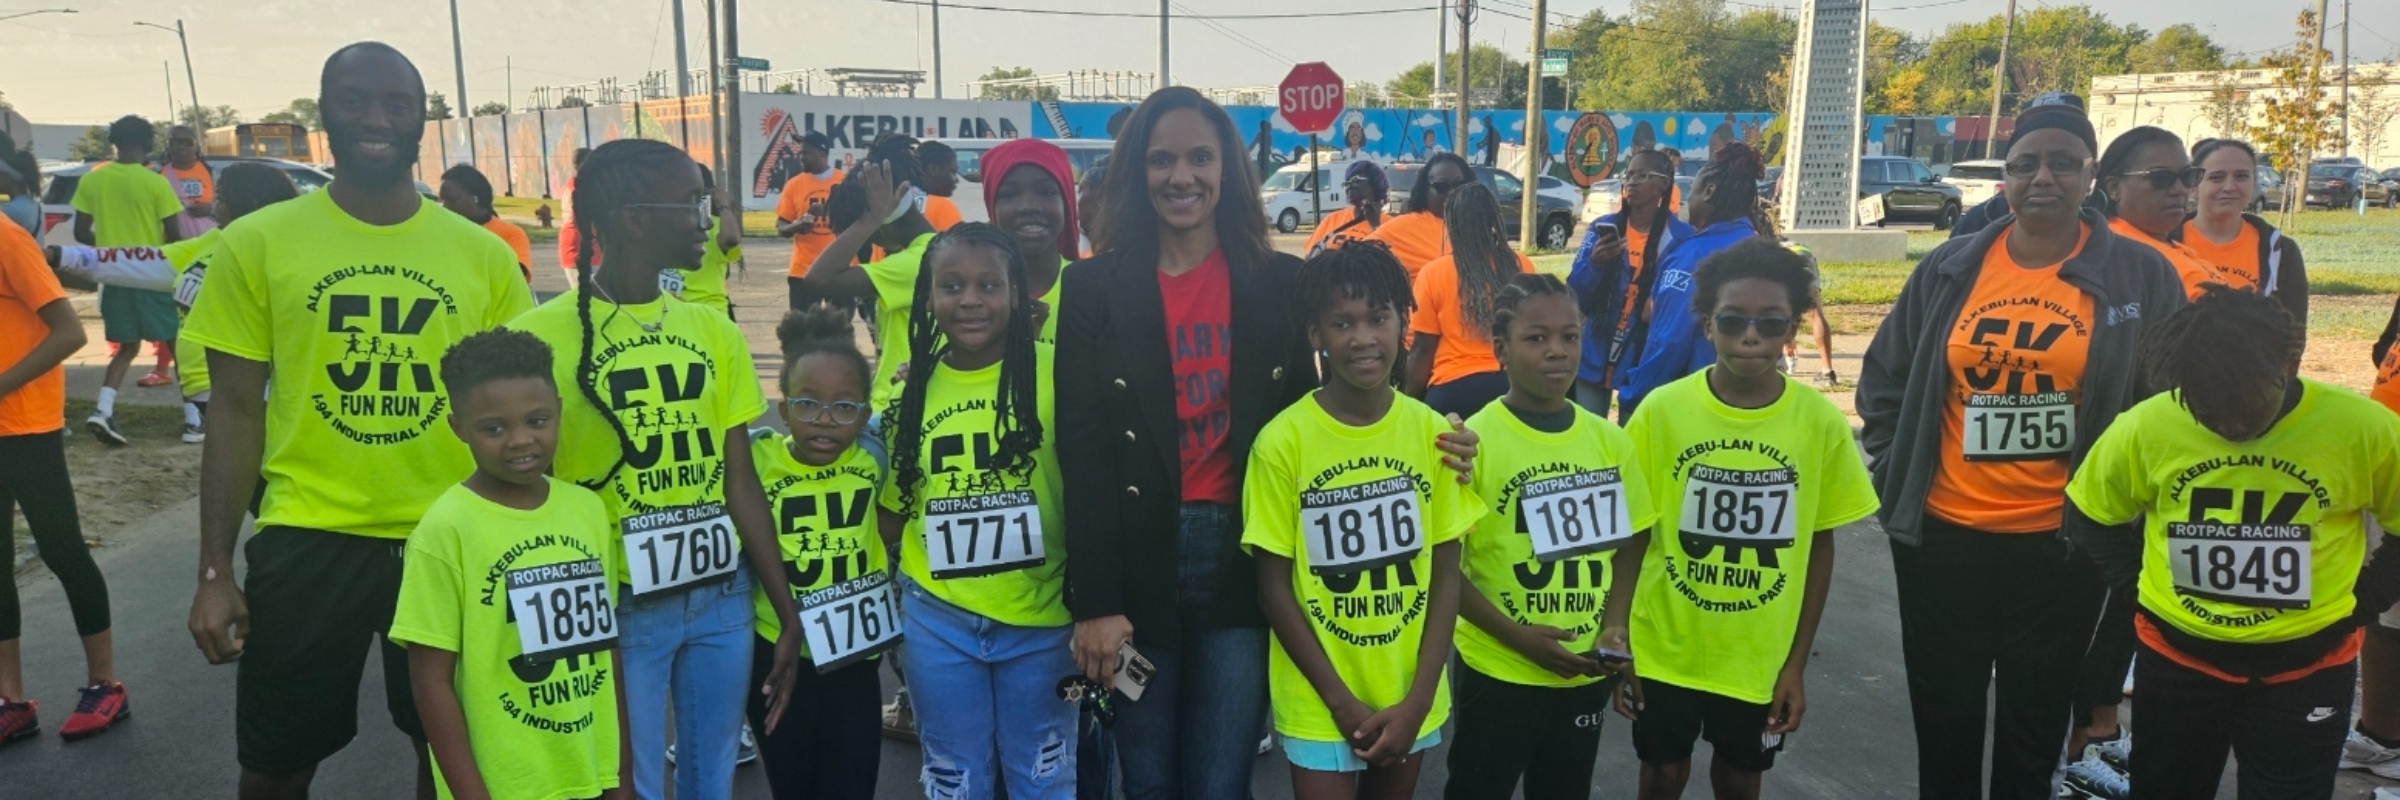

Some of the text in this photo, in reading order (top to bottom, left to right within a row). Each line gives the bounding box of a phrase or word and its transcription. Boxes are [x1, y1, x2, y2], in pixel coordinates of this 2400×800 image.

[1283, 83, 1340, 113] STOP
[307, 265, 457, 315] ALKEBU-LAN VILLAGE
[2232, 268, 2258, 284] VILLA
[1960, 297, 2087, 337] ALKEBU-LAN VILLAGE
[326, 295, 440, 392] 5K
[589, 335, 661, 382] KEBU-LAN
[1175, 322, 1230, 361] ARY
[1964, 318, 2070, 393] 5K
[312, 394, 446, 445] I-94 INDUSTRIAL PARK
[340, 395, 420, 417] FUN RUN
[608, 363, 716, 470] 5K
[1972, 394, 2016, 406] ROTPAC
[2020, 392, 2067, 405] RACING
[920, 399, 985, 442] KEBU-LAN
[1973, 410, 2068, 451] 1755
[638, 461, 706, 494] FUN RUN
[1307, 456, 1379, 490] KEBU-LAN
[1673, 439, 1753, 481] ALKEBU-LAN
[1694, 465, 1788, 484] ROTPAC RACING
[767, 466, 877, 508] KEBLAN VILLA
[930, 492, 1029, 512] ROTPAC RACING
[1307, 477, 1408, 505] ROTPAC RACING
[1496, 462, 1569, 515] ALKEBU-LAN
[1526, 470, 1615, 496] ROTPAC RACING
[2170, 455, 2331, 509] ALKEBU-LAN VILLAGE
[629, 511, 684, 530] ROTPAC
[1314, 498, 1416, 560] 1816
[1536, 489, 1617, 546] 1817
[1694, 487, 1788, 535] 1857
[2176, 524, 2301, 538] ROTPAC RACING
[639, 523, 731, 585] 1760
[782, 487, 872, 587] 5K
[936, 512, 1033, 564] 1771
[481, 534, 594, 606] ALKEBU-LAN VILL
[513, 566, 569, 585] ROTPAC
[1687, 560, 1762, 590] FUN RUN
[2181, 545, 2301, 595] 1849
[802, 583, 851, 607] ROTPAC
[1334, 591, 1403, 618] FUN RUN
[1526, 592, 1595, 613] FUN RUN
[1675, 580, 1758, 612] INDUSTRIAL
[1758, 572, 1787, 605] PARK
[525, 582, 612, 645] 1855
[814, 590, 895, 655] 1761
[1307, 589, 1427, 646] I-94 INDUSTRIAL PARK
[499, 692, 521, 718] I-94
[591, 669, 607, 696] RK
[528, 674, 591, 708] FUN RU
